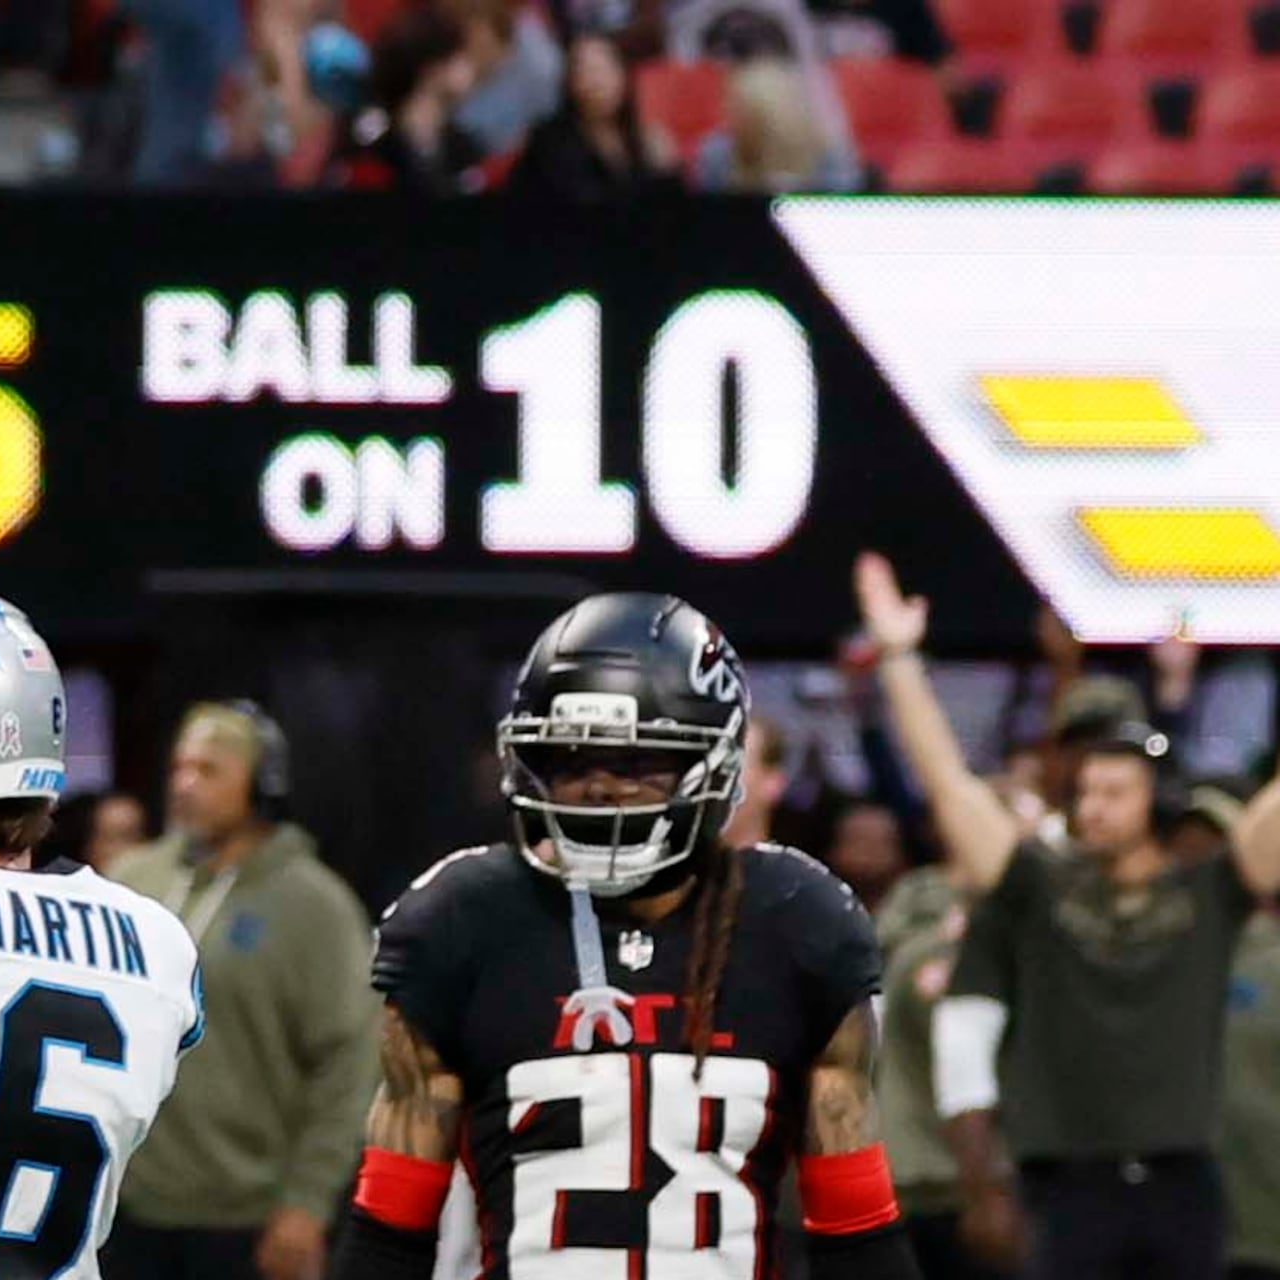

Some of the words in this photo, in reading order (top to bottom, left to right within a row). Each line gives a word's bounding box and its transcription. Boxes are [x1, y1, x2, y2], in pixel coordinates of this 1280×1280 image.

[141, 288, 453, 403] BALL
[479, 289, 819, 559] 10
[259, 432, 446, 552] ON
